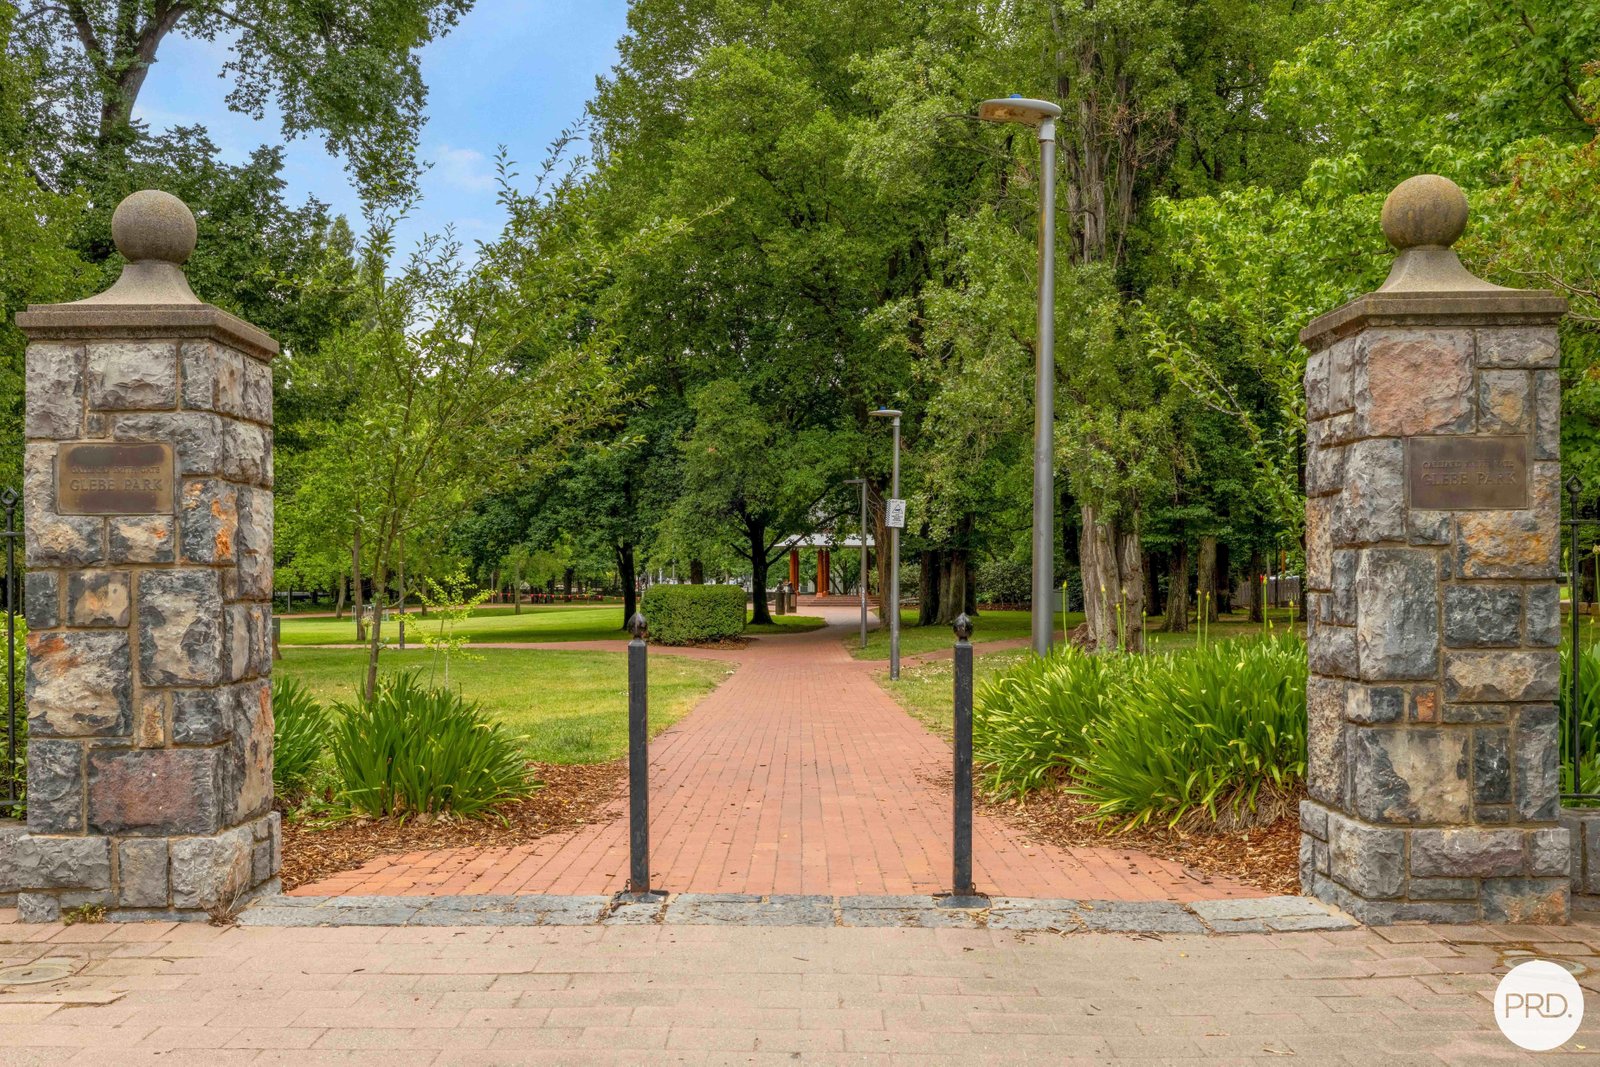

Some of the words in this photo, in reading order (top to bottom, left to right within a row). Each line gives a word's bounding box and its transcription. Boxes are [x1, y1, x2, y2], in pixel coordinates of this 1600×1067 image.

[70, 479, 115, 491] GLEBE
[124, 479, 163, 491] PARK
[1421, 471, 1468, 486] GLEBE
[1476, 471, 1518, 486] PARK
